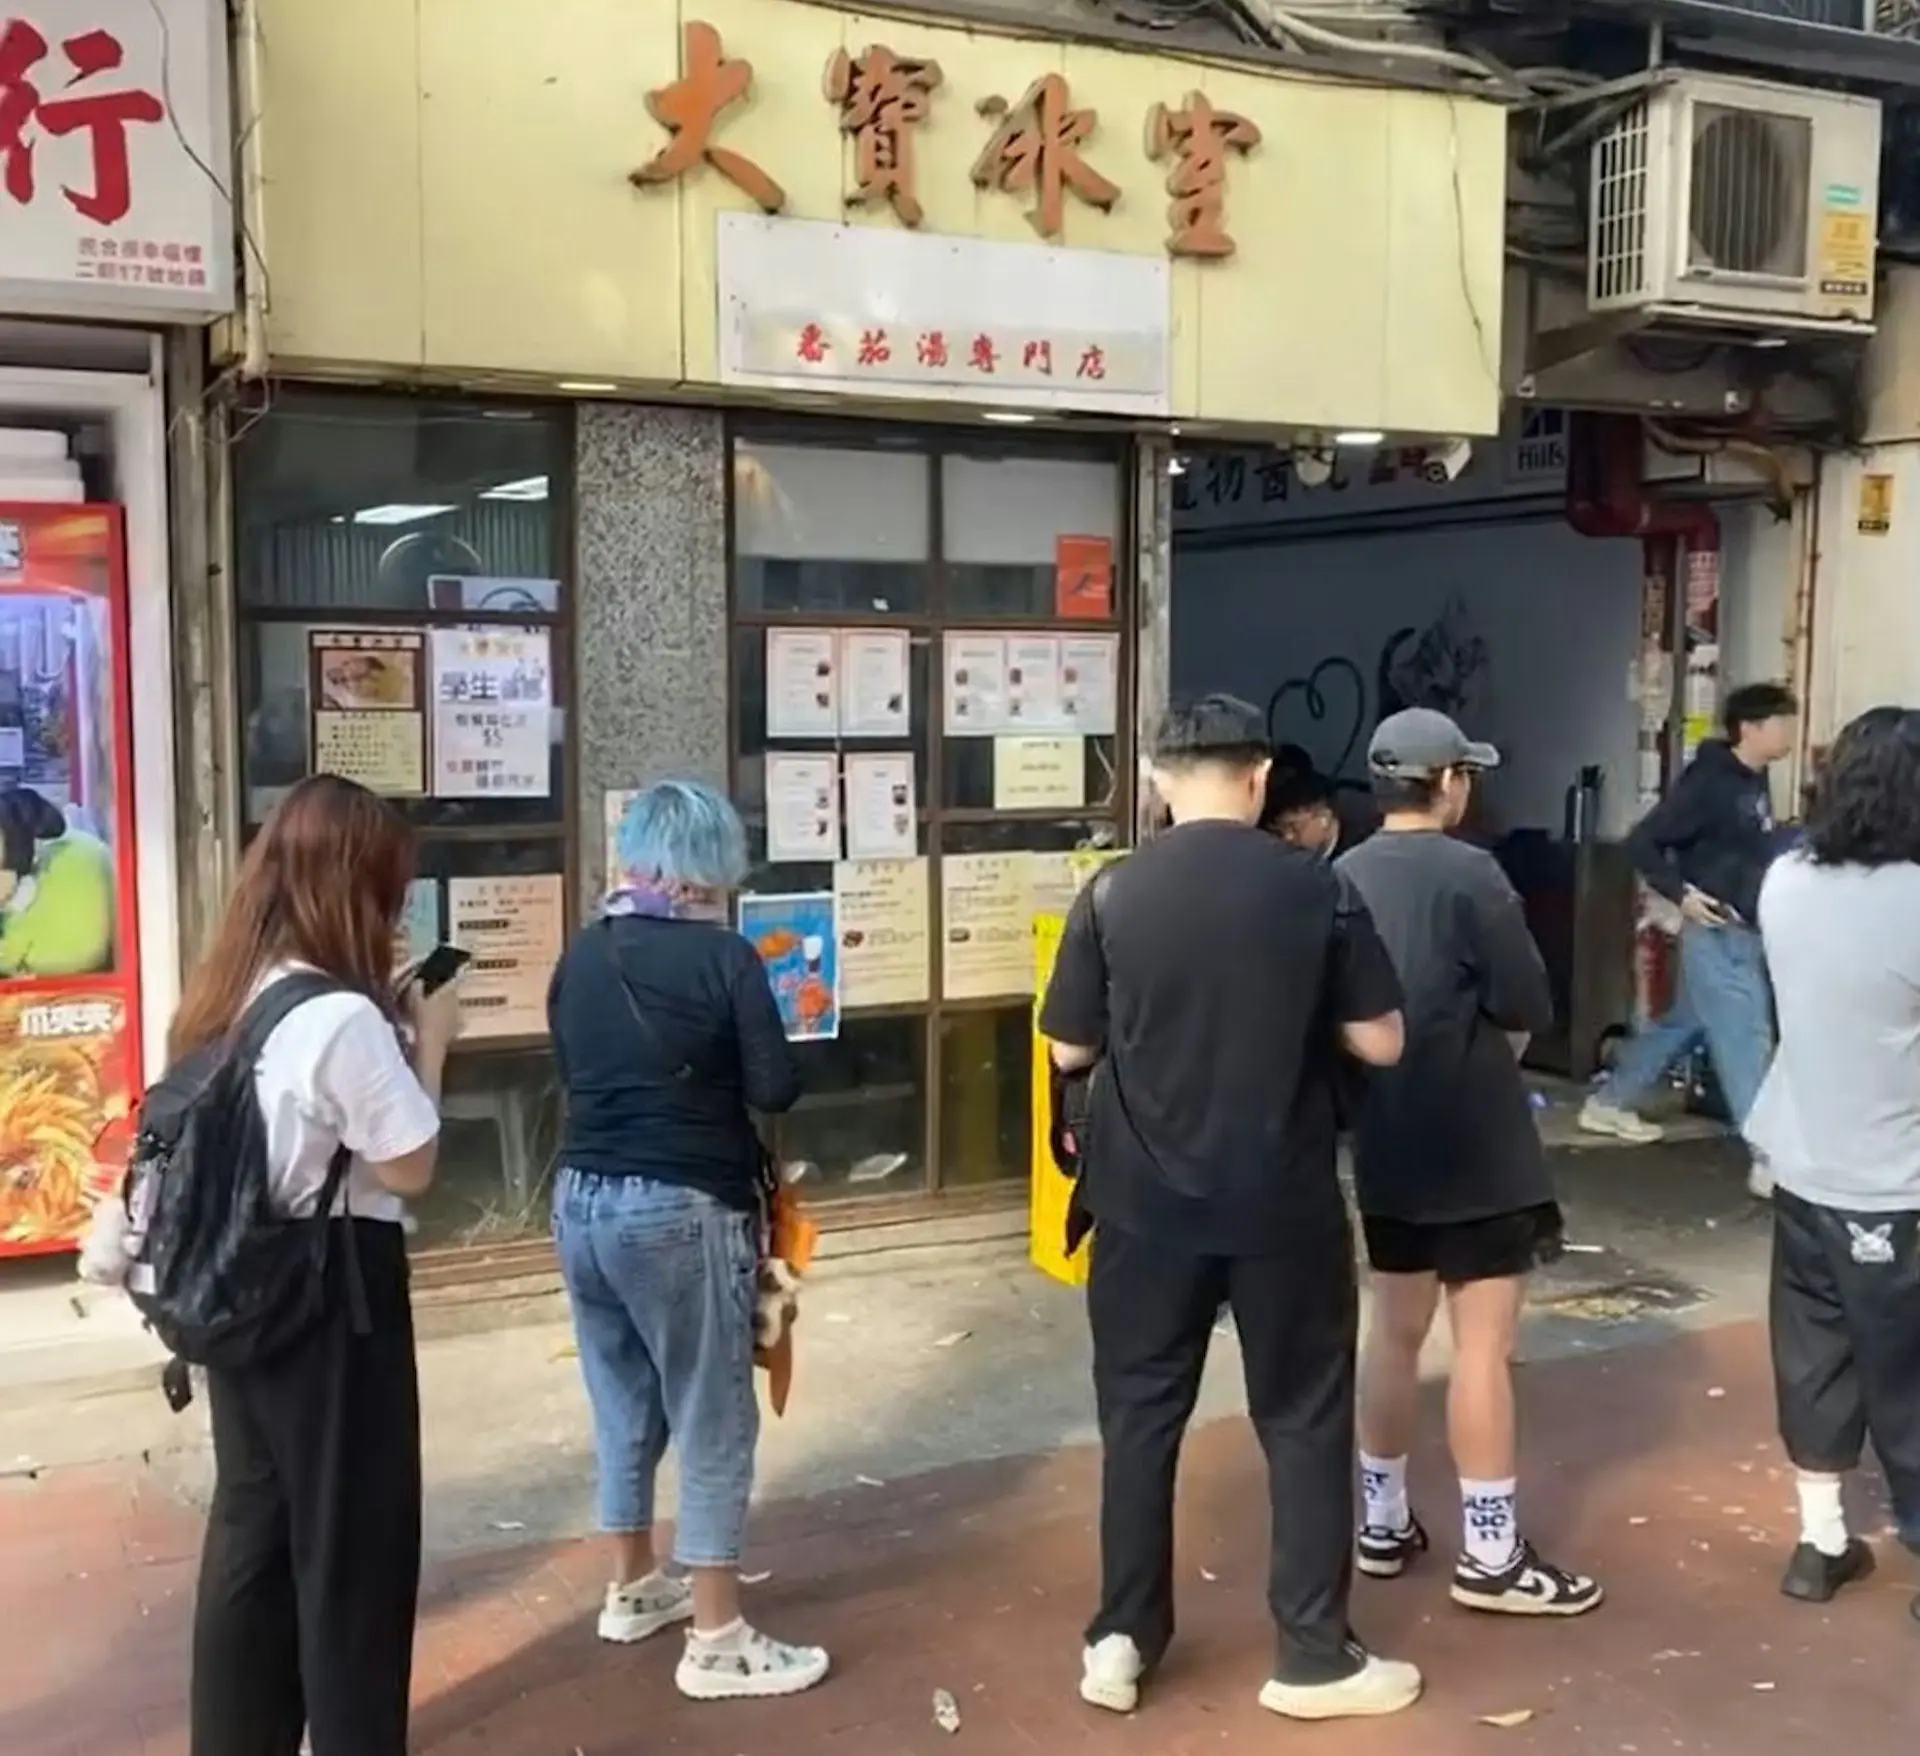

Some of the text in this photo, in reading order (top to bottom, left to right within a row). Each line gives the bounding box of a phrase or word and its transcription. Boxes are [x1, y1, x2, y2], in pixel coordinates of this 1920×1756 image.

[0, 18, 164, 226] 行
[628, 19, 1262, 260] 大寶冰室
[796, 322, 1107, 381] 番茄湯專門店
